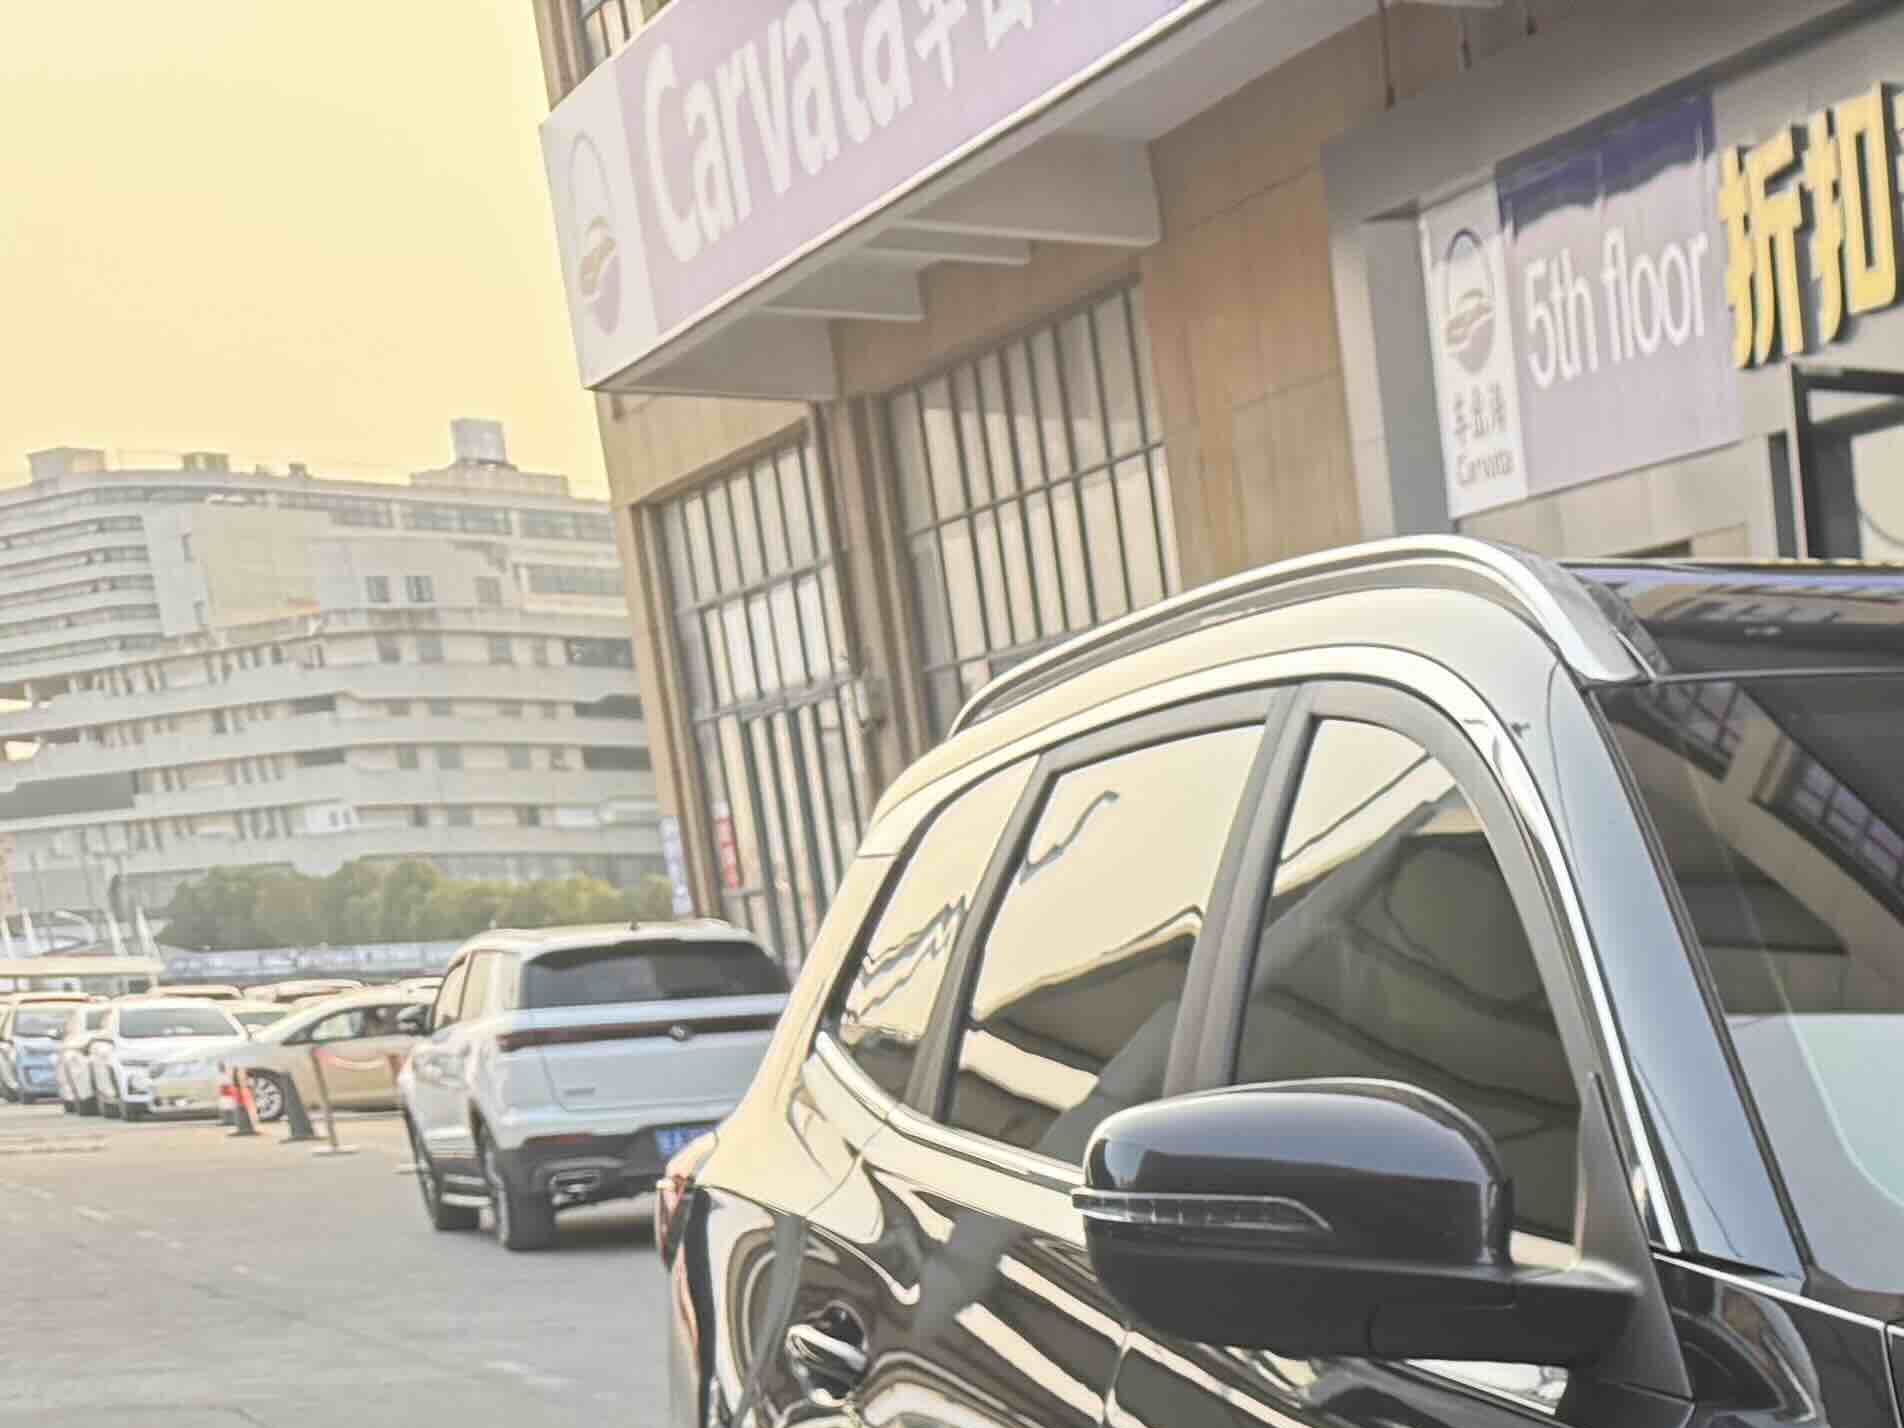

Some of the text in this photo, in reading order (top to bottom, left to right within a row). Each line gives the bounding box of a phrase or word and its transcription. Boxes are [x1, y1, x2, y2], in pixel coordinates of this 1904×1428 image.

[644, 0, 913, 263] Carvata
[1524, 225, 1709, 390] 5th floor
